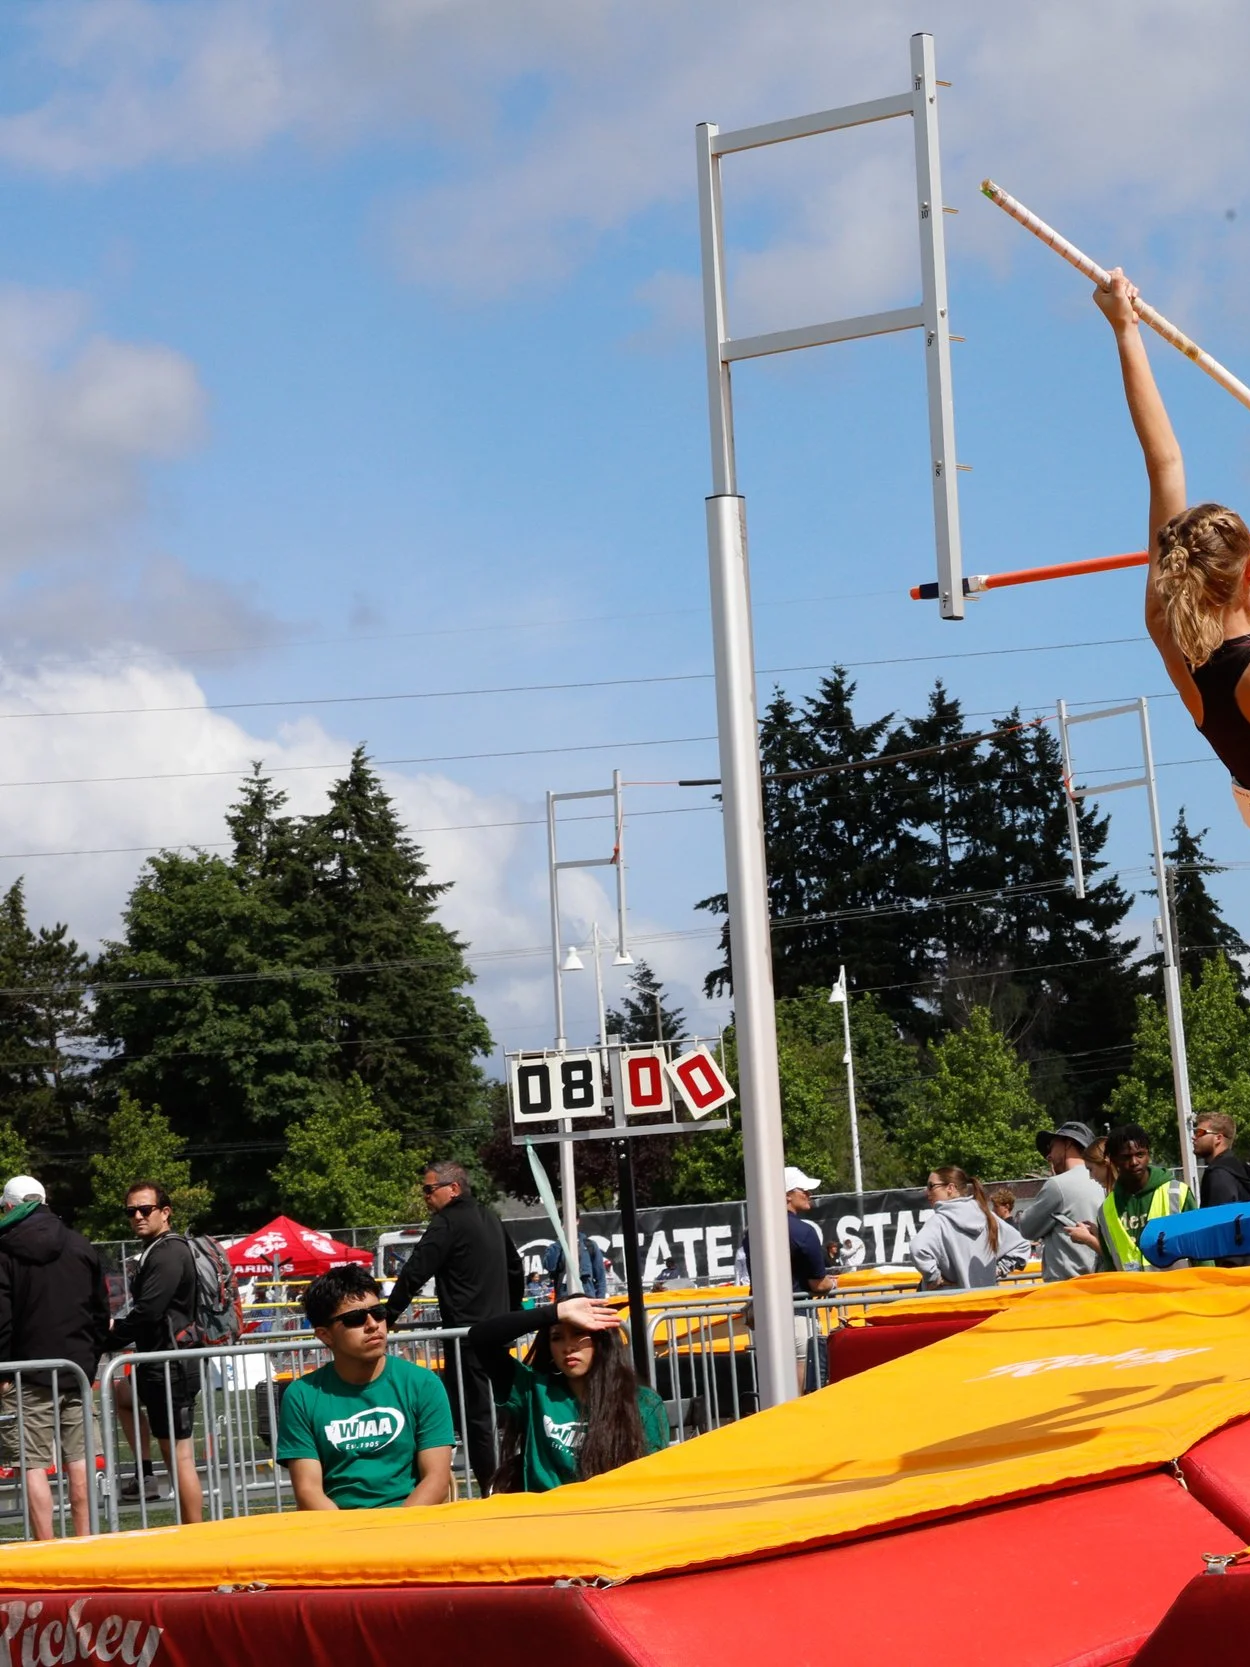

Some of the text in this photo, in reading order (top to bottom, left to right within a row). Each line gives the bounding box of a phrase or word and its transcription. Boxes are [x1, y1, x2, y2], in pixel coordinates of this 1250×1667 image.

[517, 1060, 595, 1114] 08
[234, 1263, 294, 1274] ARINS
[338, 1417, 392, 1439] WIAA
